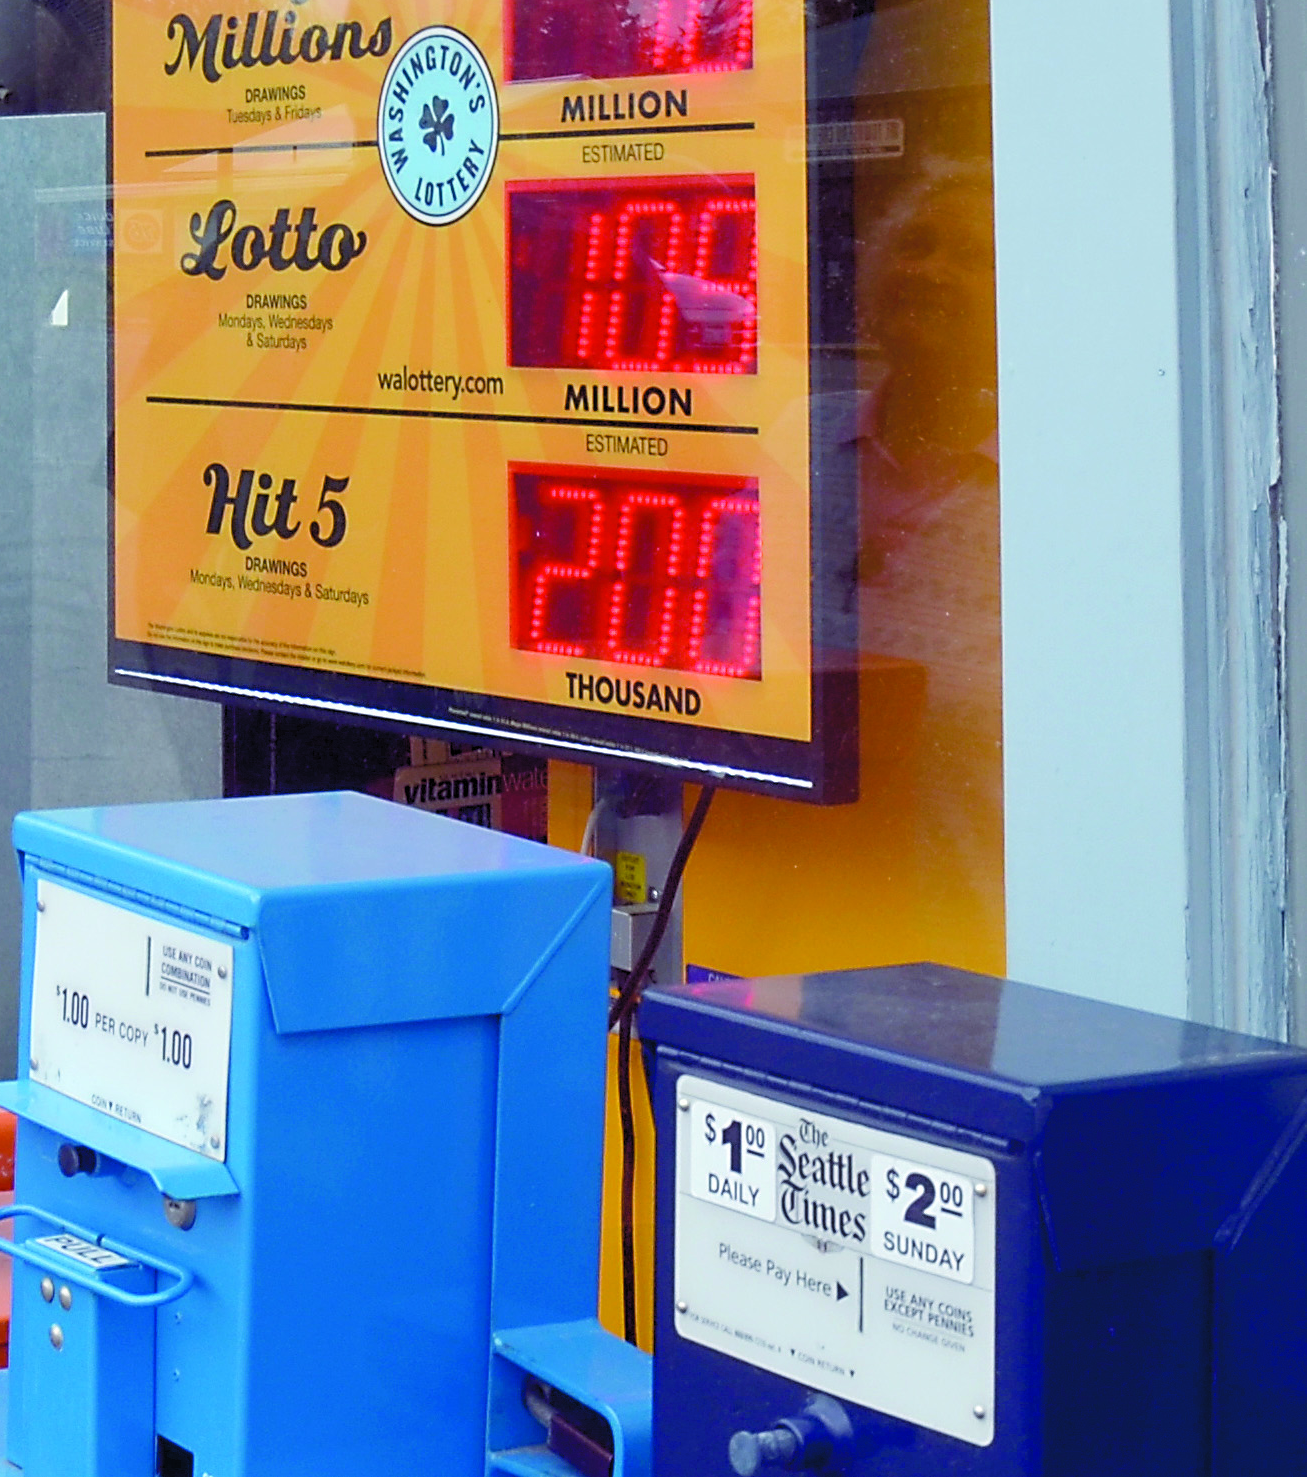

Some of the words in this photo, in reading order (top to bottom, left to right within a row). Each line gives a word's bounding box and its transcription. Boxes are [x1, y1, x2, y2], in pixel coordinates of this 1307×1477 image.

[164, 10, 392, 83] Millions
[245, 85, 306, 104] DRAWINGS
[389, 45, 485, 174] WASHINGTON'S
[561, 90, 687, 122] MILLION
[227, 108, 272, 125] Tuesdays
[275, 107, 281, 120] &
[285, 105, 322, 122] Fridays
[582, 143, 664, 163] ESTIMATED
[415, 139, 485, 207] LOTTERY
[180, 199, 367, 280] Lotto
[246, 295, 307, 309] DRAWINGS
[218, 314, 265, 330] Mondays,
[268, 315, 333, 332] Wednesdays
[246, 334, 254, 347] &
[256, 334, 307, 351] Saturdays
[378, 366, 504, 400] walottery.com
[565, 385, 692, 416] MILLION
[586, 434, 668, 457] ESTIMATED
[203, 462, 301, 550] Hit
[309, 475, 350, 548] 5
[246, 556, 307, 577] DRAWINGS
[190, 569, 234, 591] Mondays,
[238, 575, 301, 600] Wednesdays
[305, 583, 312, 598] &
[315, 583, 369, 607] Saturdays
[565, 673, 701, 716] THOUSAND
[162, 945, 175, 959] USE
[178, 950, 193, 965] ANY
[195, 954, 213, 972] COIN
[161, 962, 211, 989] COMBINATION
[168, 984, 178, 995] NOT
[179, 988, 188, 998] USE
[189, 990, 211, 1007] PENNIES
[56, 985, 89, 1029] $1.00
[95, 1012, 115, 1034] PER
[119, 1022, 148, 1048] COPY
[154, 1023, 192, 1069] $1.00
[92, 1094, 107, 1111] COIN
[115, 1103, 142, 1124] RETURN
[799, 1118, 828, 1149] The
[777, 1134, 870, 1199] Seattle
[708, 1173, 759, 1207] DAILY
[781, 1180, 867, 1243] Times
[43, 1236, 111, 1263] PULL
[884, 1231, 965, 1272] SUNDAY
[719, 1243, 762, 1274] Please
[767, 1260, 791, 1285] Pay
[796, 1269, 832, 1297] Here
[884, 1299, 923, 1323] EXCEPT
[928, 1311, 974, 1338] PENNIES
[886, 1286, 906, 1303] USE
[910, 1293, 934, 1311] ANY
[938, 1301, 973, 1324] COINS
[893, 1323, 905, 1334] NO
[907, 1326, 938, 1346] CHANGE
[941, 1335, 965, 1353] GIVEN
[798, 1352, 815, 1366] COIN
